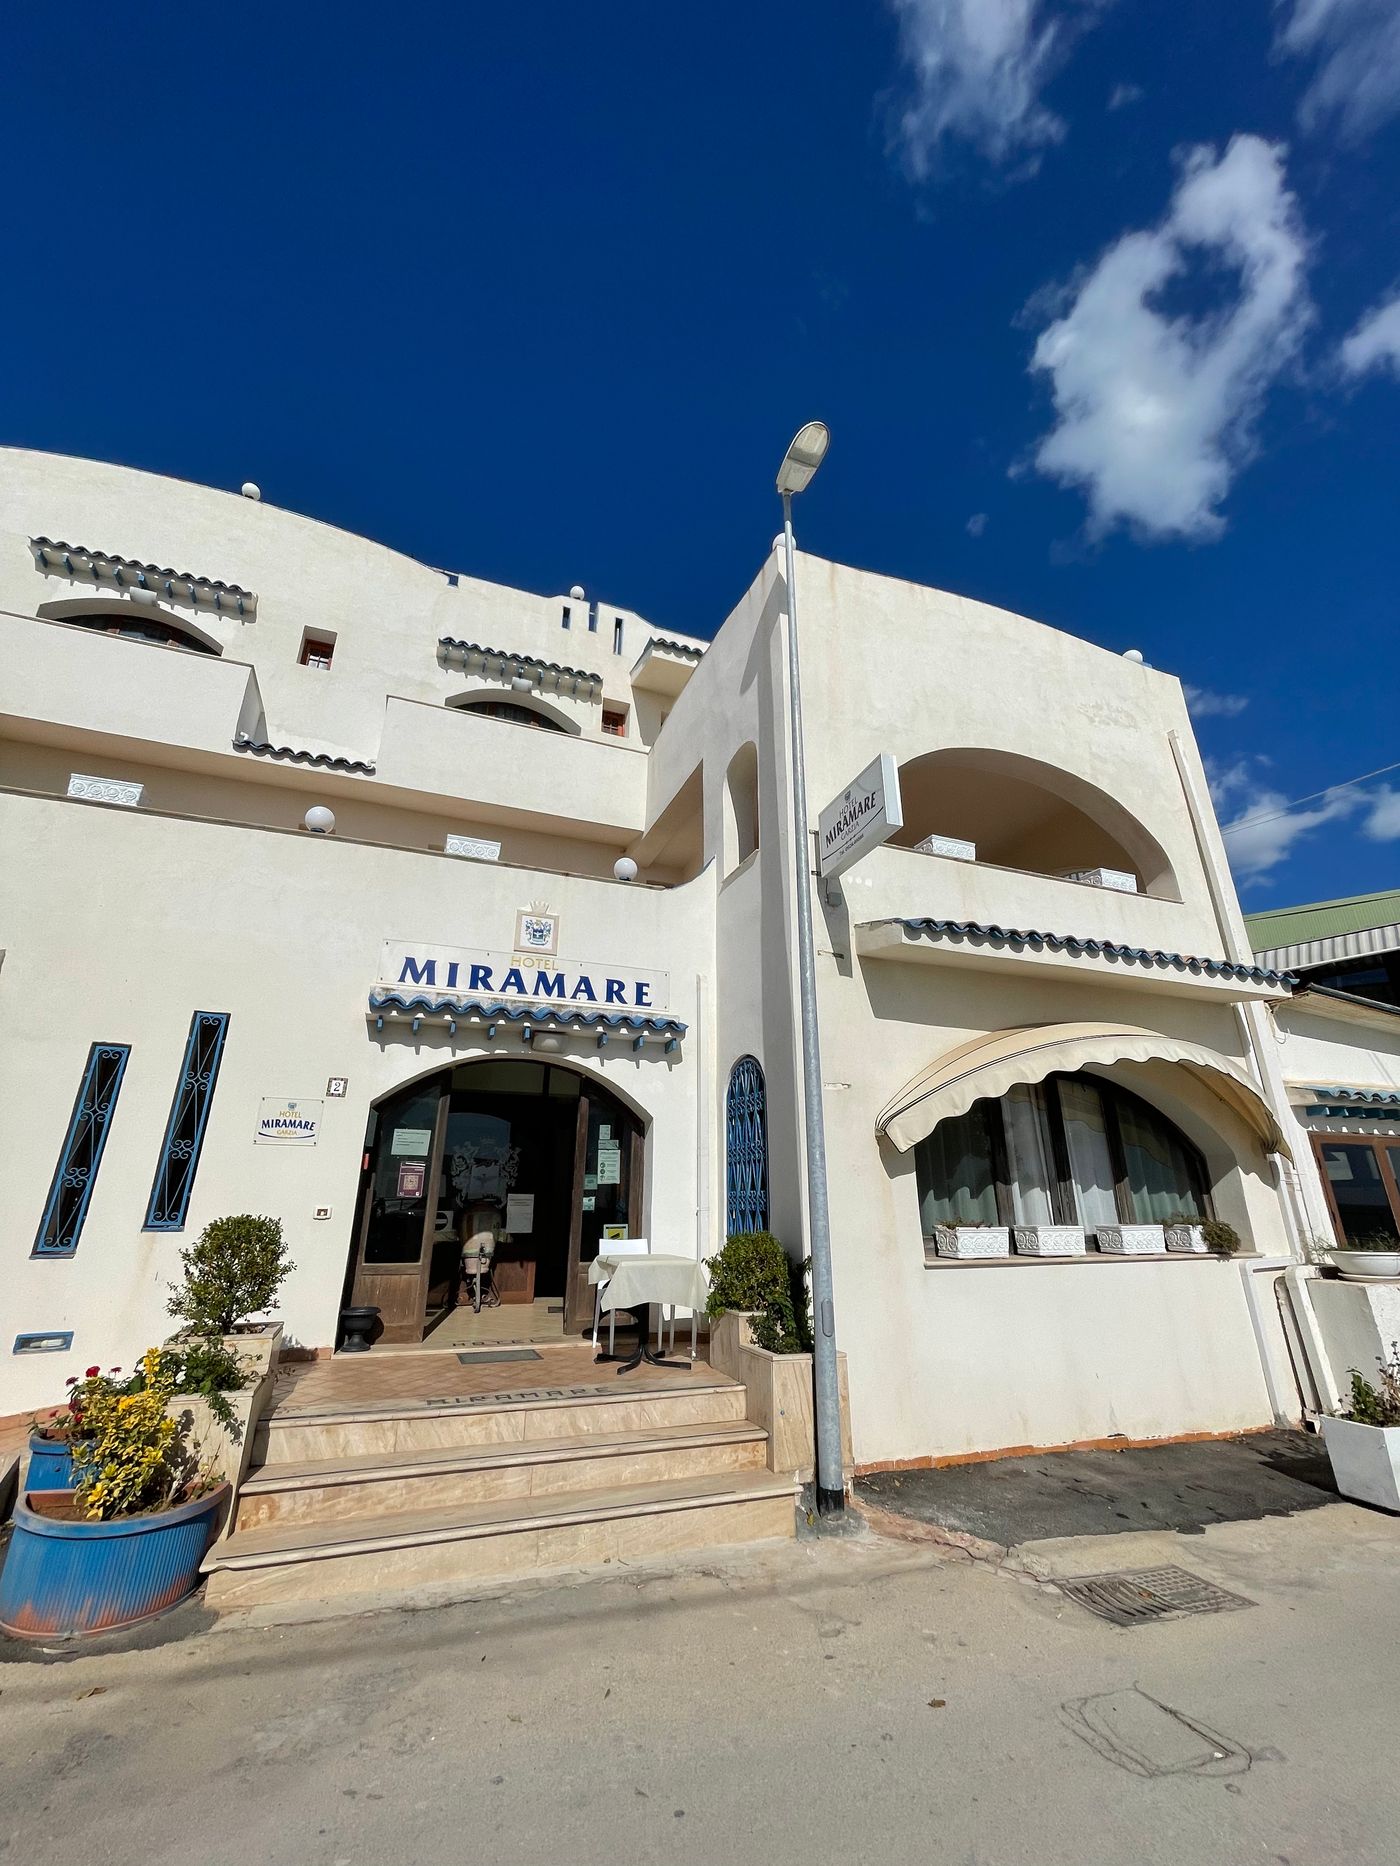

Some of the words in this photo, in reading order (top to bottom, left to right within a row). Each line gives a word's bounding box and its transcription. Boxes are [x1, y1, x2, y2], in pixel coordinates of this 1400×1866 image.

[839, 797, 858, 816] HOTEL
[825, 791, 876, 848] MIRAMARE
[510, 955, 559, 972] HOTEL
[397, 956, 653, 1007] MIRAMARE
[333, 1081, 341, 1092] 2
[279, 1110, 302, 1119] HOTEL
[261, 1118, 316, 1131] MIRAMARE
[451, 1337, 542, 1347] HOTEL
[426, 1386, 613, 1406] MIRAMARE
